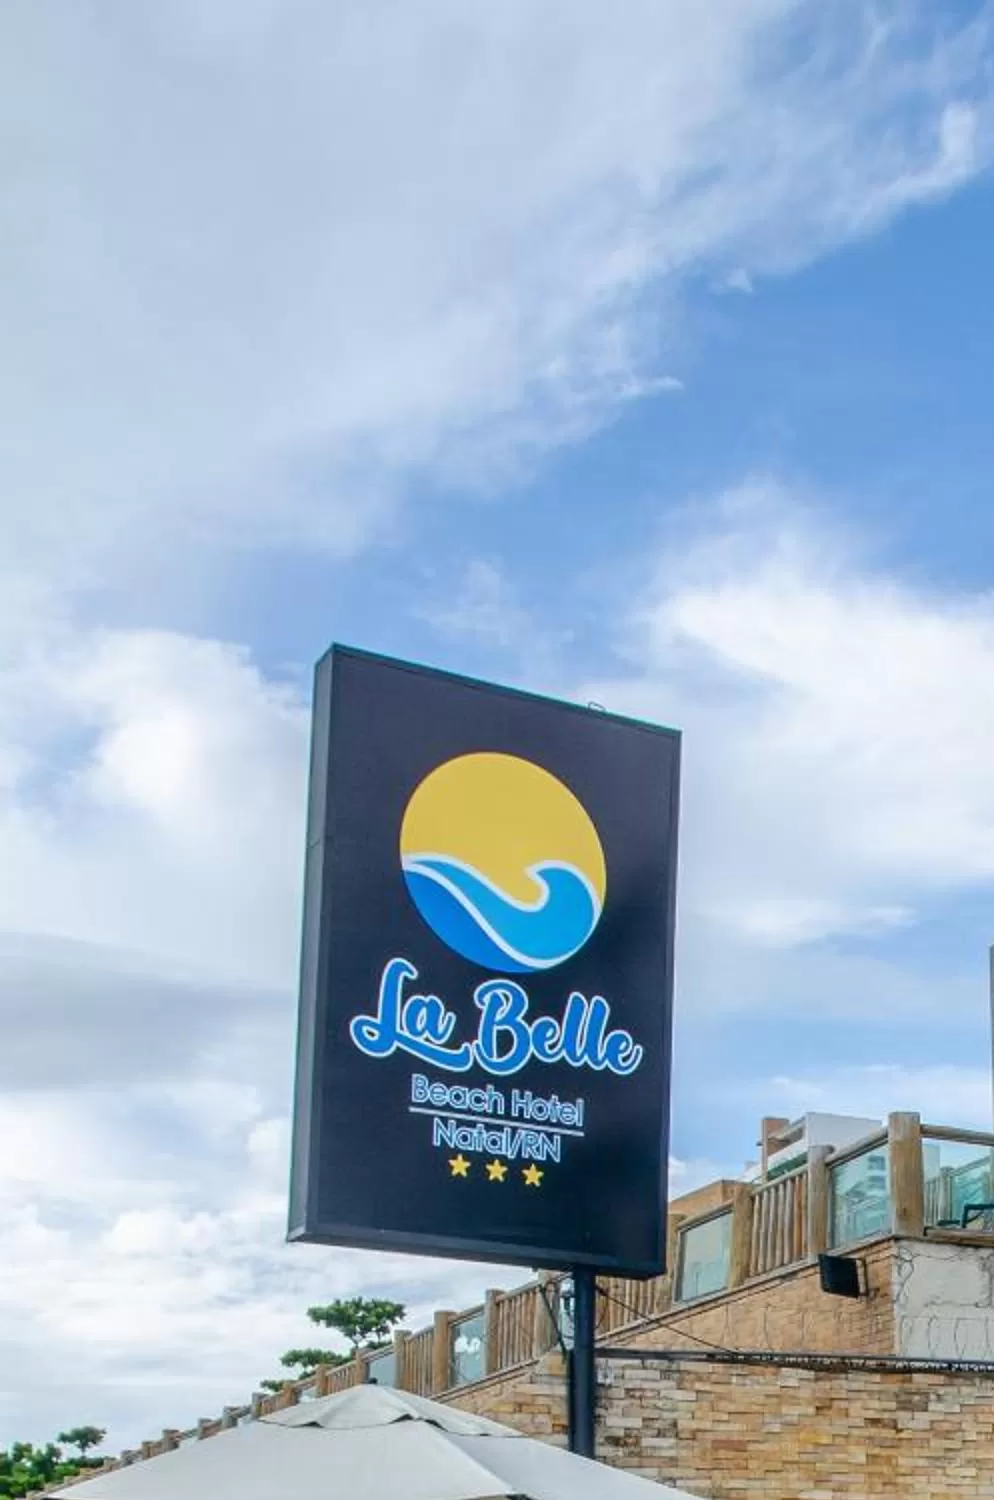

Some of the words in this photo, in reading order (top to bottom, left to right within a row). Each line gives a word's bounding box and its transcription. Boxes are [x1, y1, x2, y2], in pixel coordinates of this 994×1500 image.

[350, 957, 473, 1072] La
[473, 978, 643, 1076] Belle
[410, 1073, 505, 1115] Beach
[511, 1089, 584, 1127] Hotel
[432, 1117, 561, 1163] Natal/RN
